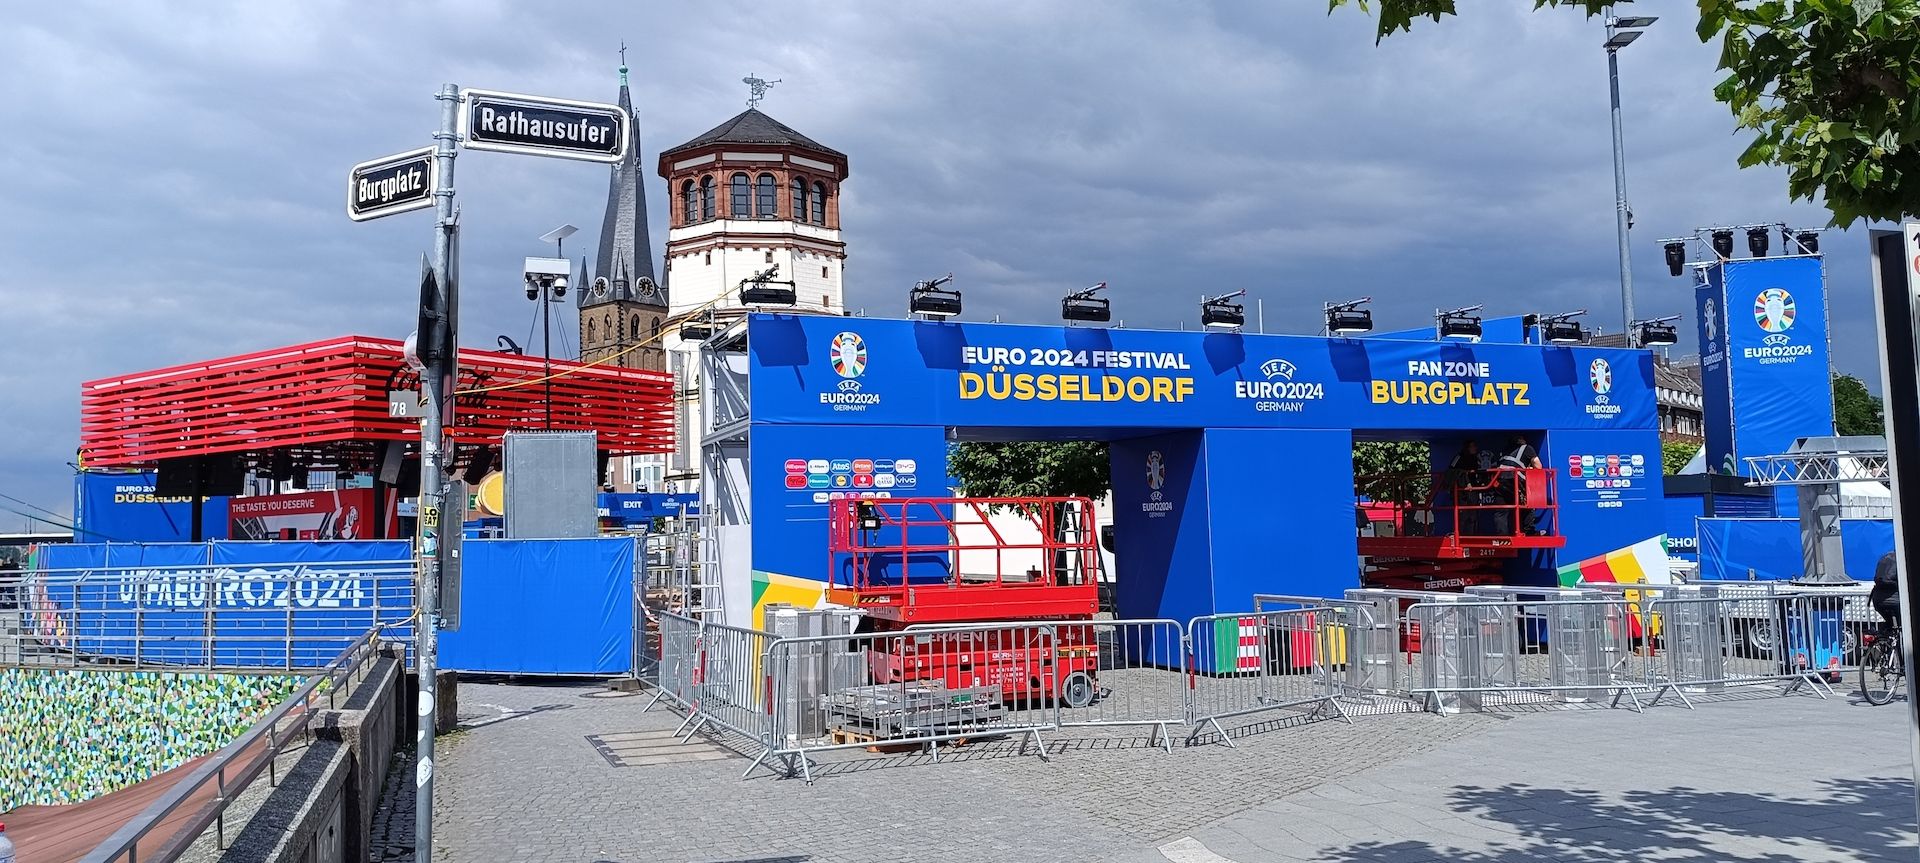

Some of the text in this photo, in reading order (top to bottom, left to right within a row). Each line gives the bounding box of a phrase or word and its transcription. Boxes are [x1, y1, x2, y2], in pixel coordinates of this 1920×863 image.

[481, 107, 609, 144] Rathausufer
[359, 168, 422, 202] Burgplatz
[1764, 335, 1788, 346] UEFA
[962, 346, 1190, 370] EURO 2024 FESTIVAL
[1744, 345, 1812, 358] EURO2024
[1759, 357, 1797, 365] GERMANY
[1262, 362, 1294, 378] UEFA
[1408, 360, 1489, 377] FAN ZONE
[838, 382, 860, 391] UEFA
[959, 366, 1194, 402] DÜSSELDORF
[1235, 381, 1324, 400] EURO2024
[820, 392, 880, 404] EURO2024
[1371, 380, 1530, 405] BURGPLATZ
[391, 401, 407, 416] 78
[833, 404, 866, 412] GERMANY
[1256, 402, 1304, 412] GERMANY
[1585, 405, 1621, 414] EURO2024
[897, 476, 916, 484] vivo
[232, 499, 315, 513] THE TASTE YOU DESERVE
[1142, 502, 1173, 511] EURO2024
[1424, 577, 1465, 589] GERKEN
[929, 630, 983, 643] ERKEN
